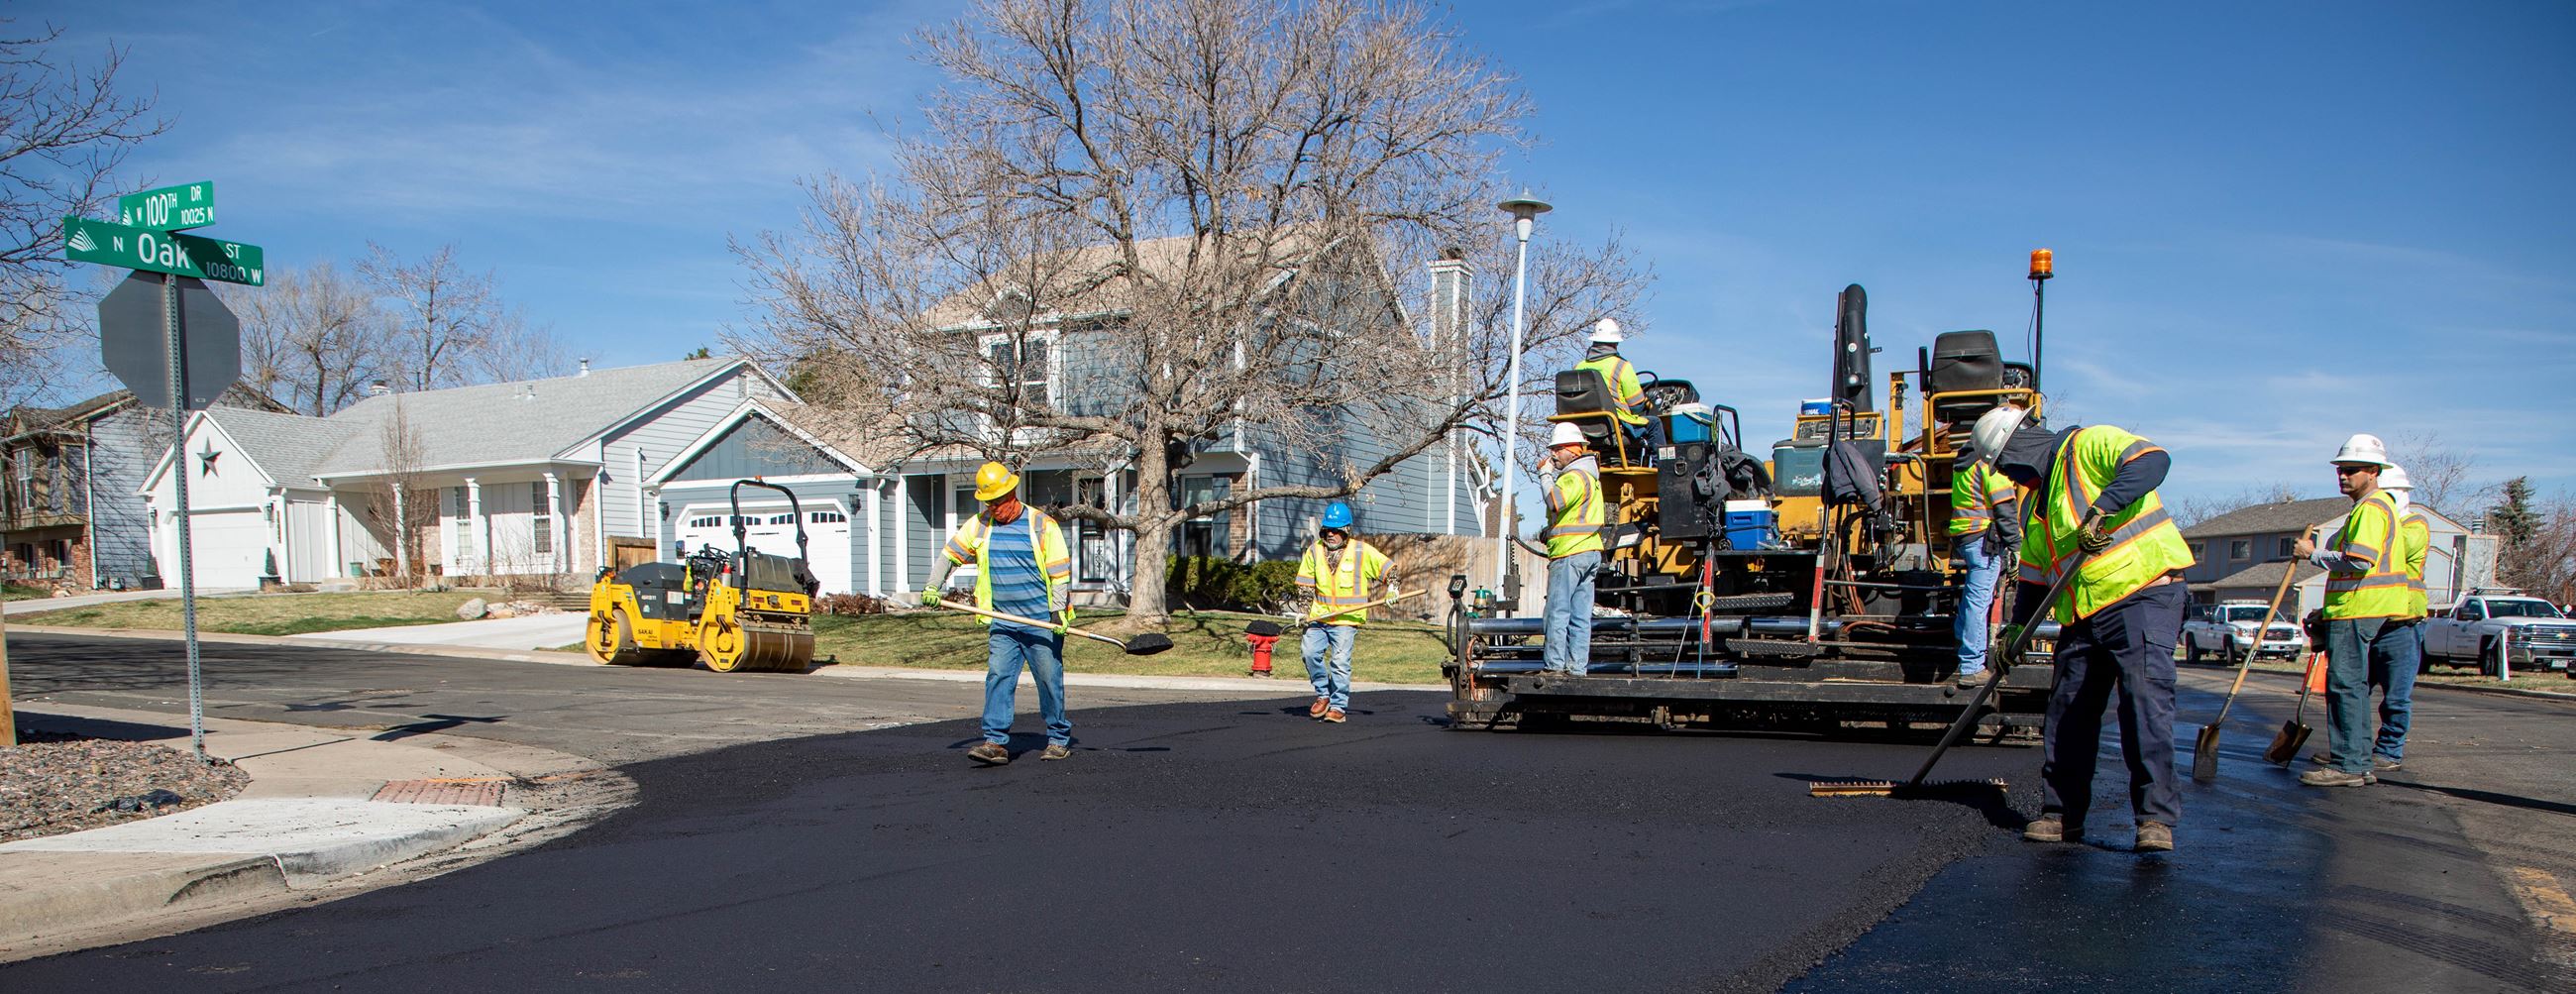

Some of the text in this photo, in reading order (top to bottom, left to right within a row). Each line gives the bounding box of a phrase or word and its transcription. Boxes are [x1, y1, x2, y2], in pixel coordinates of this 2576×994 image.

[136, 206, 143, 223] W
[190, 185, 202, 202] DR
[180, 206, 214, 225] 10025 N
[113, 233, 242, 270] N Oak ST
[205, 261, 263, 284] 10800 W
